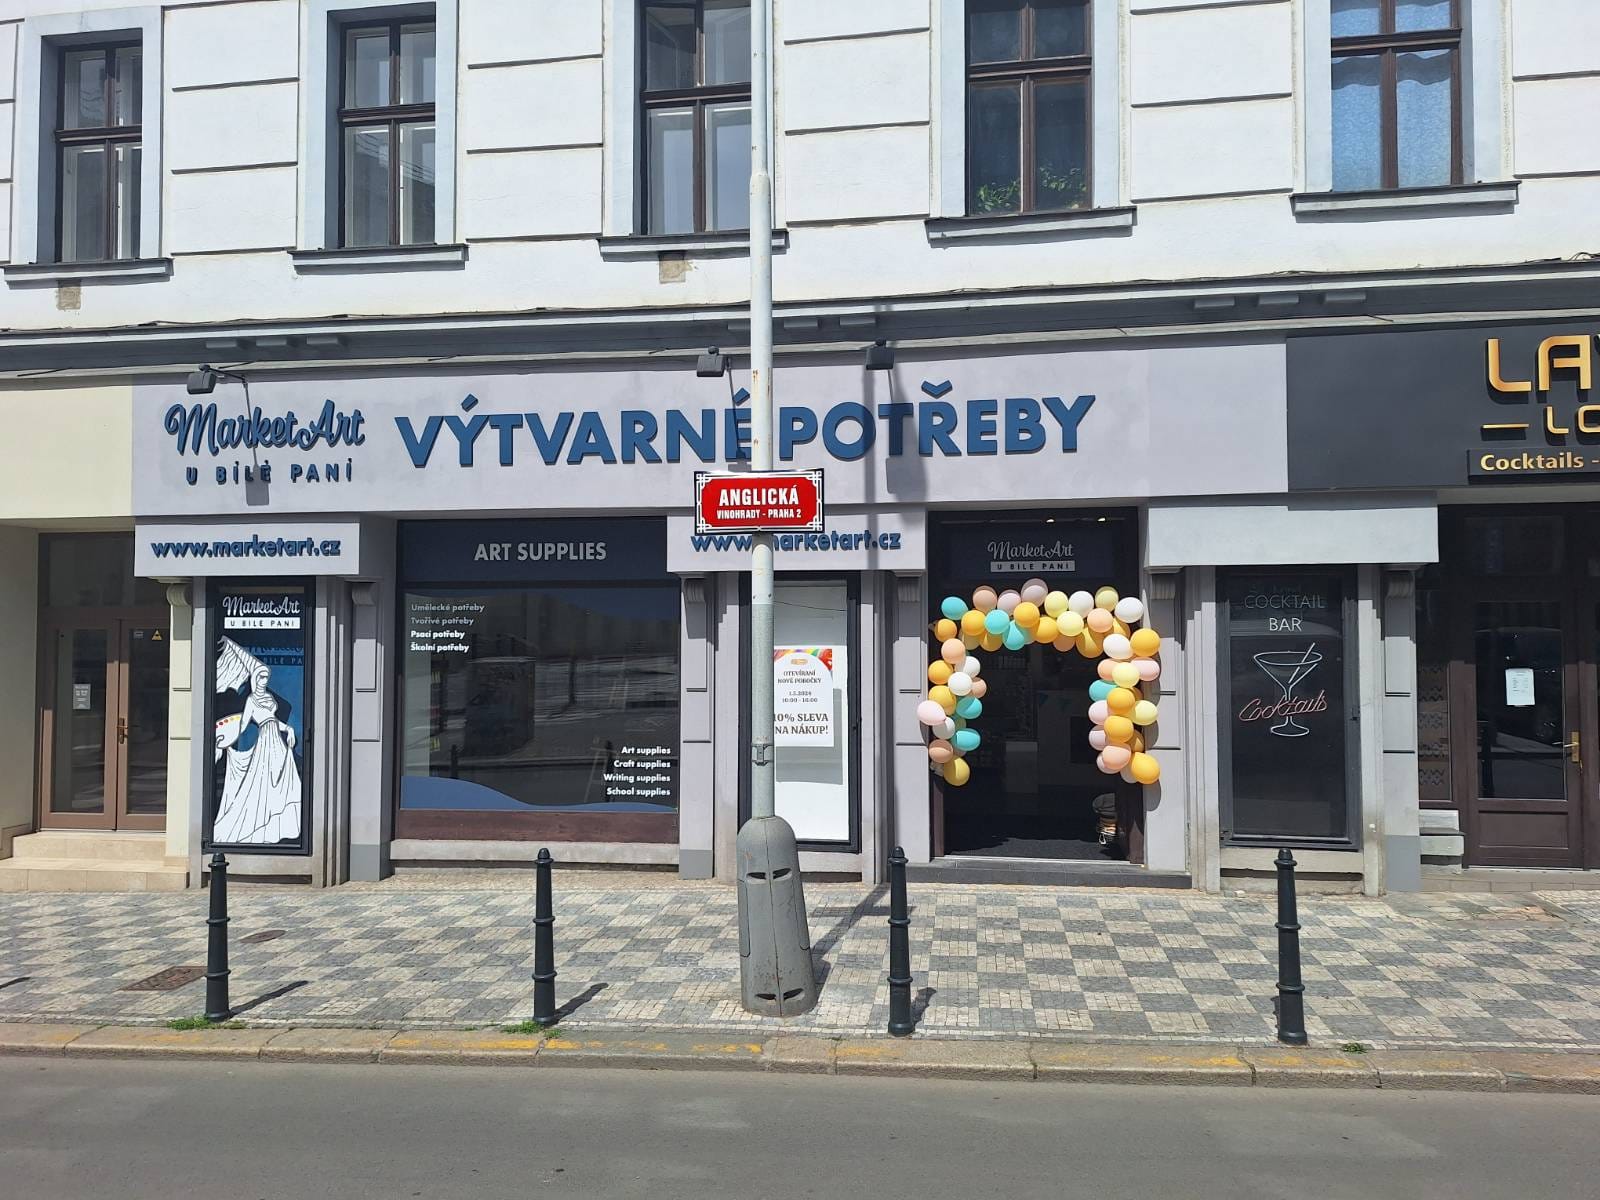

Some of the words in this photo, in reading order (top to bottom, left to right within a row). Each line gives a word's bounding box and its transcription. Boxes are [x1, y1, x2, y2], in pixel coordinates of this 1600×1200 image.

[1487, 334, 1600, 392] LA
[394, 393, 752, 467] VÝTVARNÉ
[779, 380, 1096, 462] POTŘEBY
[1480, 451, 1584, 471] Cocktails
[186, 466, 198, 485] U
[719, 485, 799, 507] ANGLICKÁ
[716, 509, 760, 520] VINOHRADY
[768, 509, 794, 519] PRAHA
[796, 508, 802, 519] 2
[151, 534, 341, 558] www.marketart.cz
[690, 530, 901, 553] wwwarketart.cz
[474, 543, 512, 561] ART
[517, 542, 607, 561] SUPPLIES
[411, 603, 450, 611] Umělecké
[452, 603, 485, 613] potřeby
[1244, 595, 1326, 609] COCKTAIL
[441, 617, 474, 626] potřeby
[1269, 617, 1302, 632] BAR
[432, 630, 466, 639] potřeby
[410, 642, 436, 651] Školní
[437, 643, 470, 653] potřeby
[1239, 689, 1327, 721] Cocktails
[797, 713, 829, 722] SLEVA
[775, 725, 789, 735] NA
[791, 723, 829, 735] NÁKUP!
[621, 746, 635, 754] Art
[636, 746, 671, 756] supplies
[613, 760, 635, 768] Craft
[636, 760, 671, 770] supplies
[603, 773, 635, 783] Writing
[636, 773, 671, 783] supplies
[606, 787, 635, 796] School
[636, 787, 671, 797] supplies
